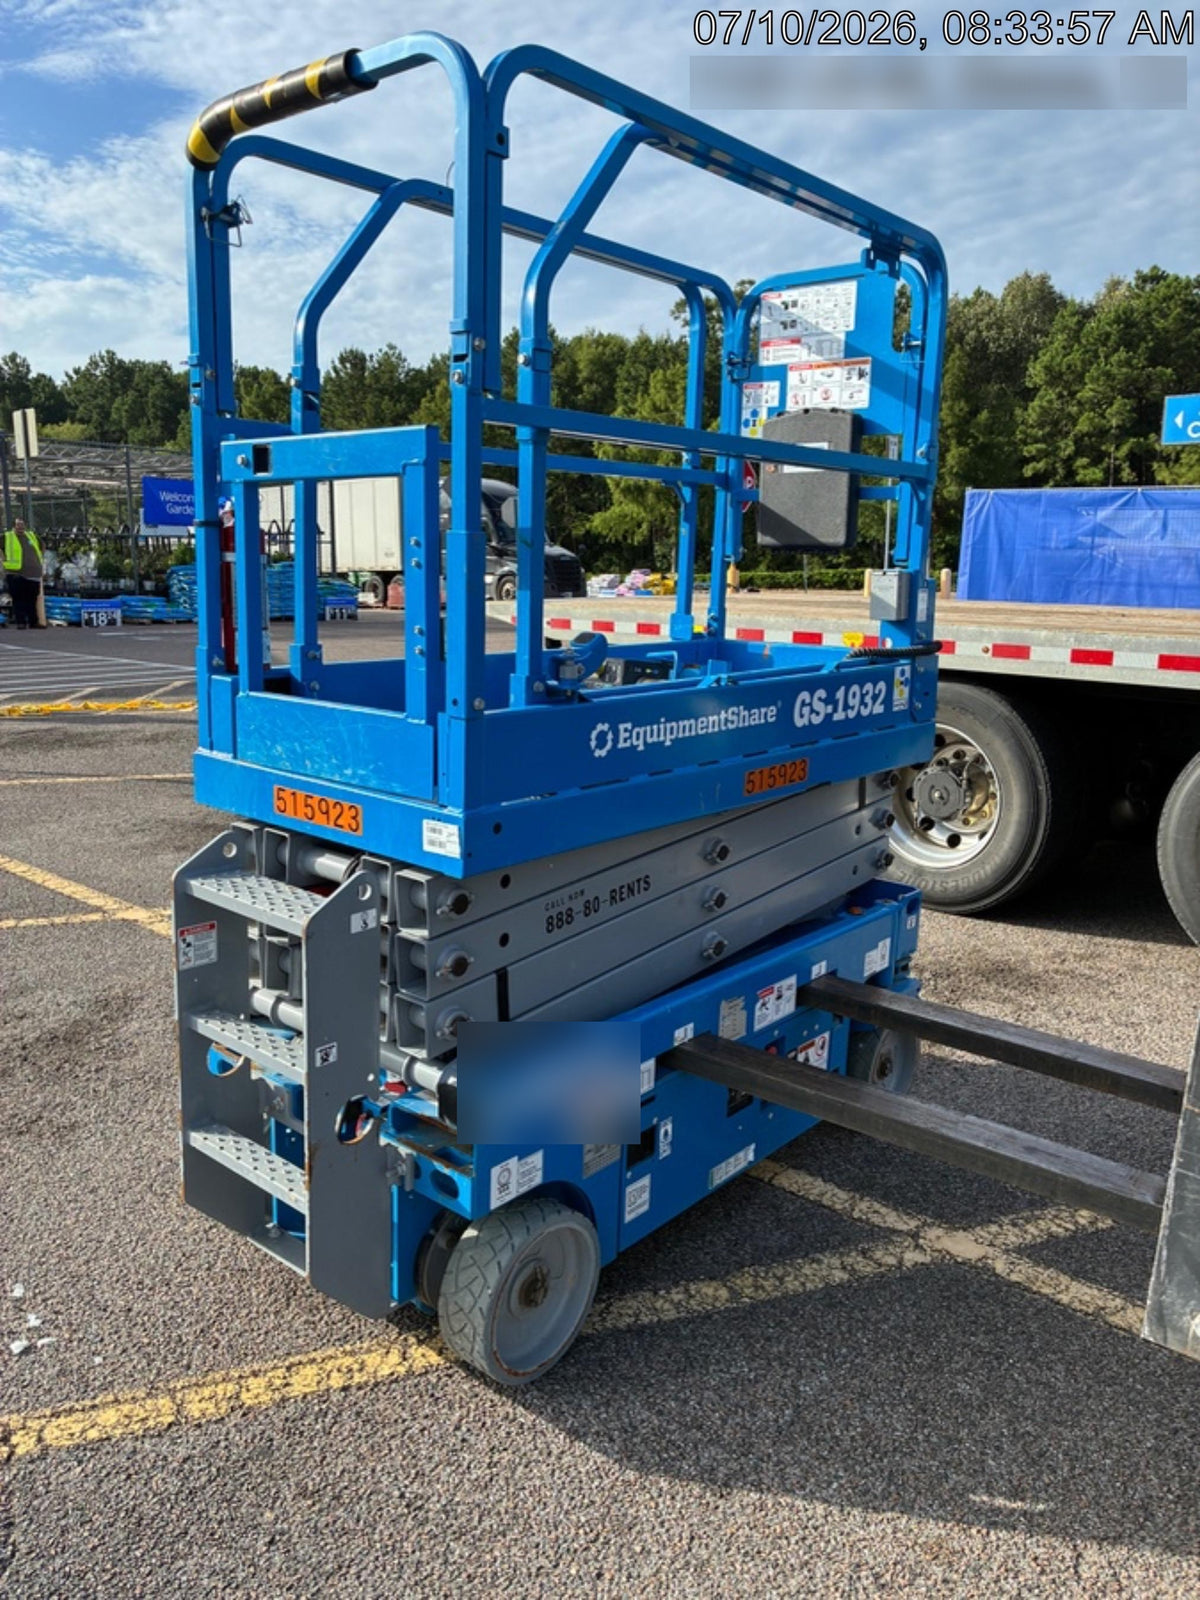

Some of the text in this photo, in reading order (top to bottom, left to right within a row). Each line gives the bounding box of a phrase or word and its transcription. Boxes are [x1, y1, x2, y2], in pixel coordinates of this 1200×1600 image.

[618, 681, 887, 751] EquipmentShare GS-1932
[745, 761, 808, 795] 515923
[276, 787, 360, 833] 515923
[545, 874, 652, 934] 888-80-RENTS
